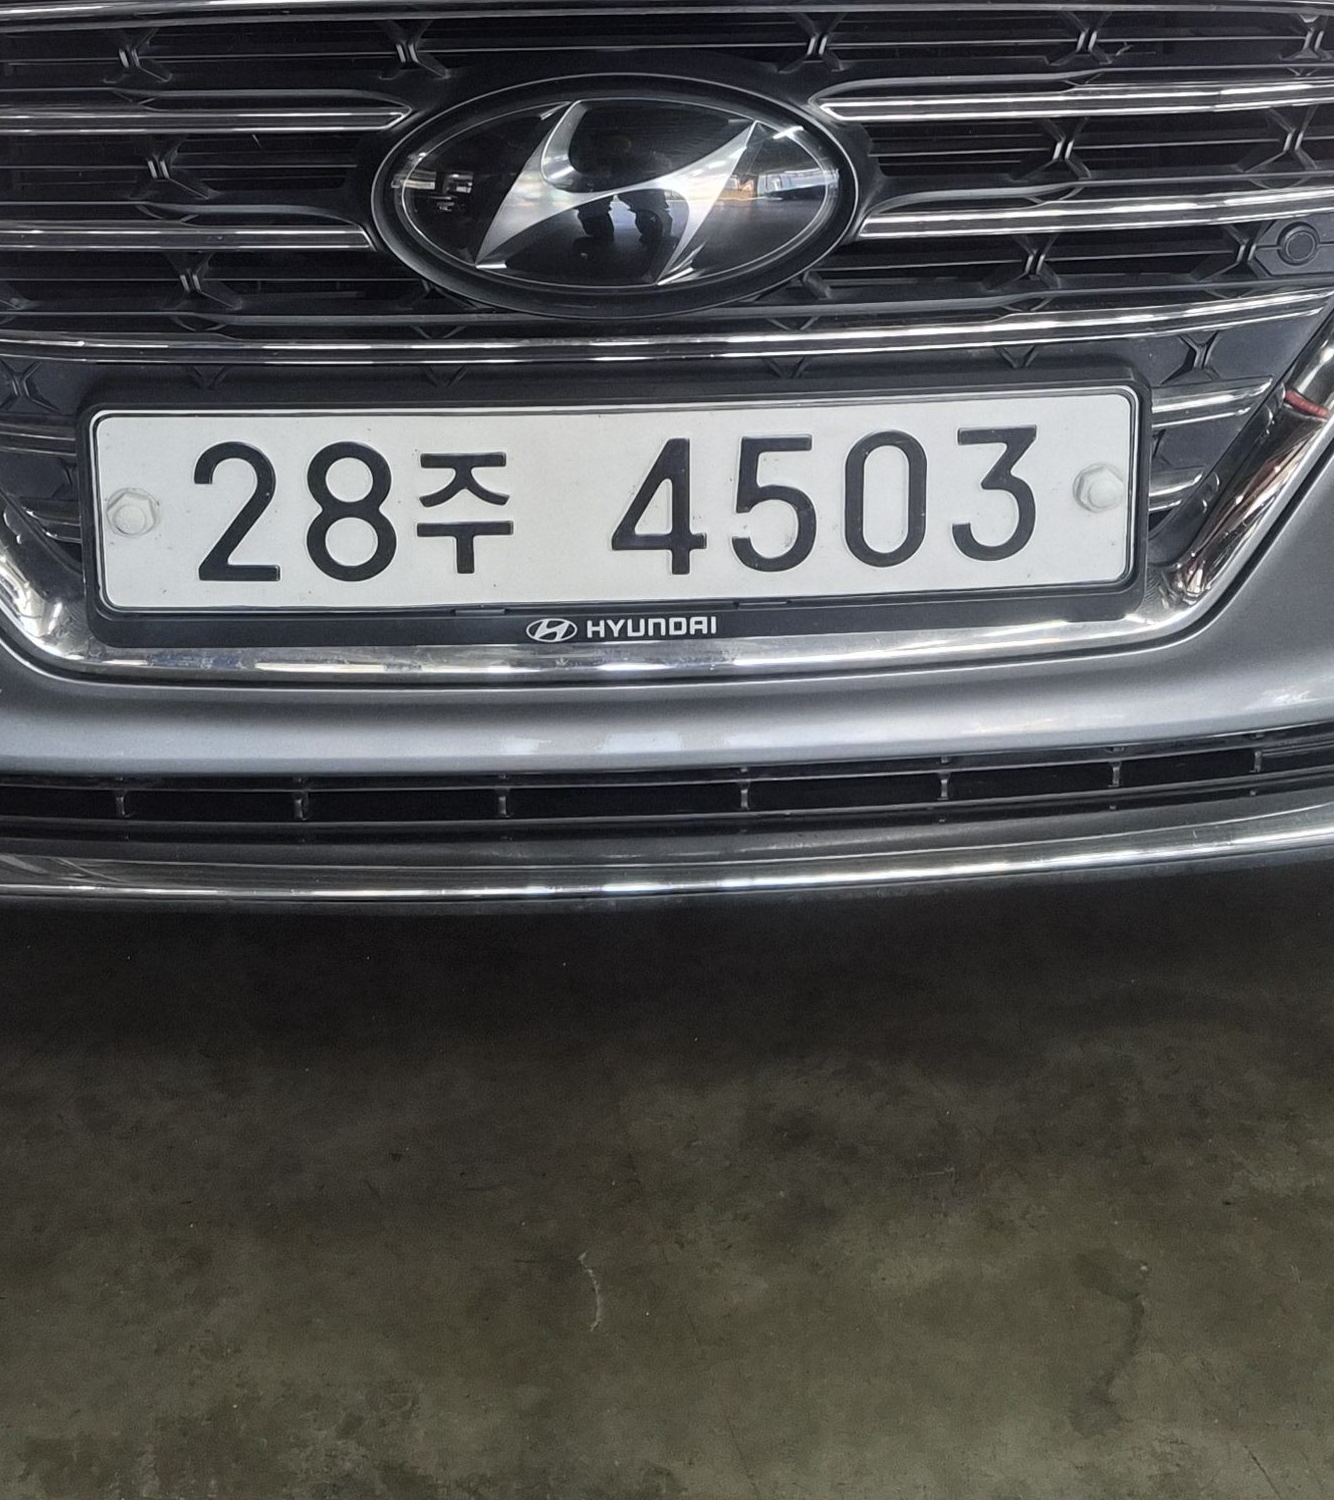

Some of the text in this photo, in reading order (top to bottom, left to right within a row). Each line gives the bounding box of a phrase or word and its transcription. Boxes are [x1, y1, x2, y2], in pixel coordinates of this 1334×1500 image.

[193, 424, 1039, 584] 28주 4503
[586, 615, 718, 638] HYUNDAI
